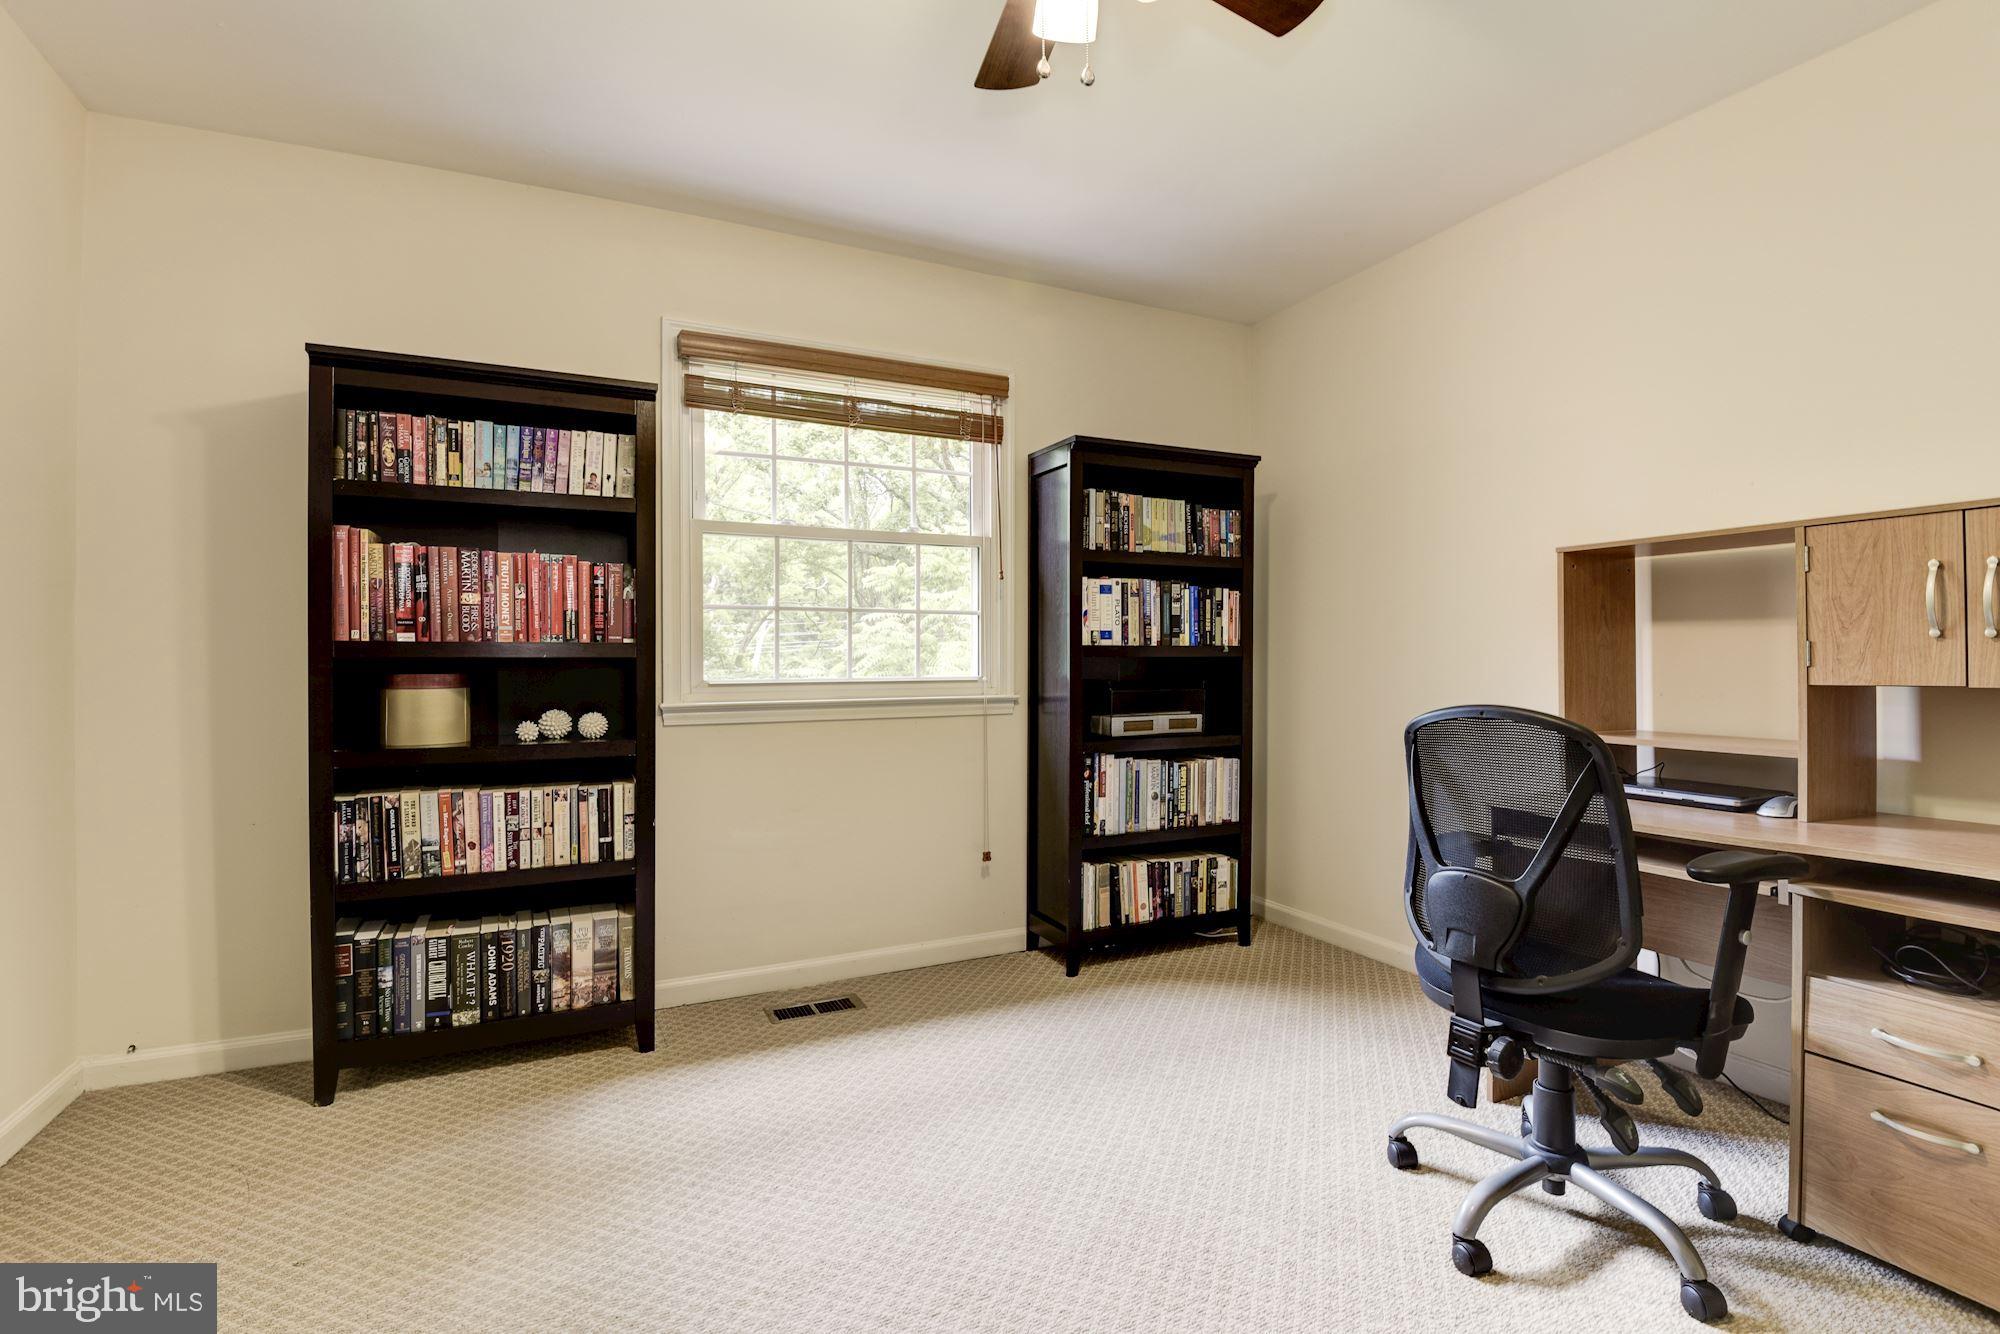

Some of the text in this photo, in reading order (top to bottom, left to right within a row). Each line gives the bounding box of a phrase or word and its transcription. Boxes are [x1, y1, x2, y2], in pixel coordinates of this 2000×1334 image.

[370, 548, 378, 576] MARTIN
[460, 551, 472, 592] MARTIN
[501, 560, 510, 626] TRUTH MONEY
[462, 606, 470, 632] BLOOD
[471, 606, 479, 631] FIRE &
[428, 939, 438, 959] GILBERT
[438, 938, 446, 958] MARTIN
[502, 939, 515, 972] 1920
[538, 938, 546, 969] PACIFIC
[428, 960, 446, 1000] CHURCHILL
[466, 951, 476, 984] WHAT
[488, 944, 497, 1006] JOHN ADAMS
[386, 988, 392, 996] NO
[466, 987, 476, 998] IF
